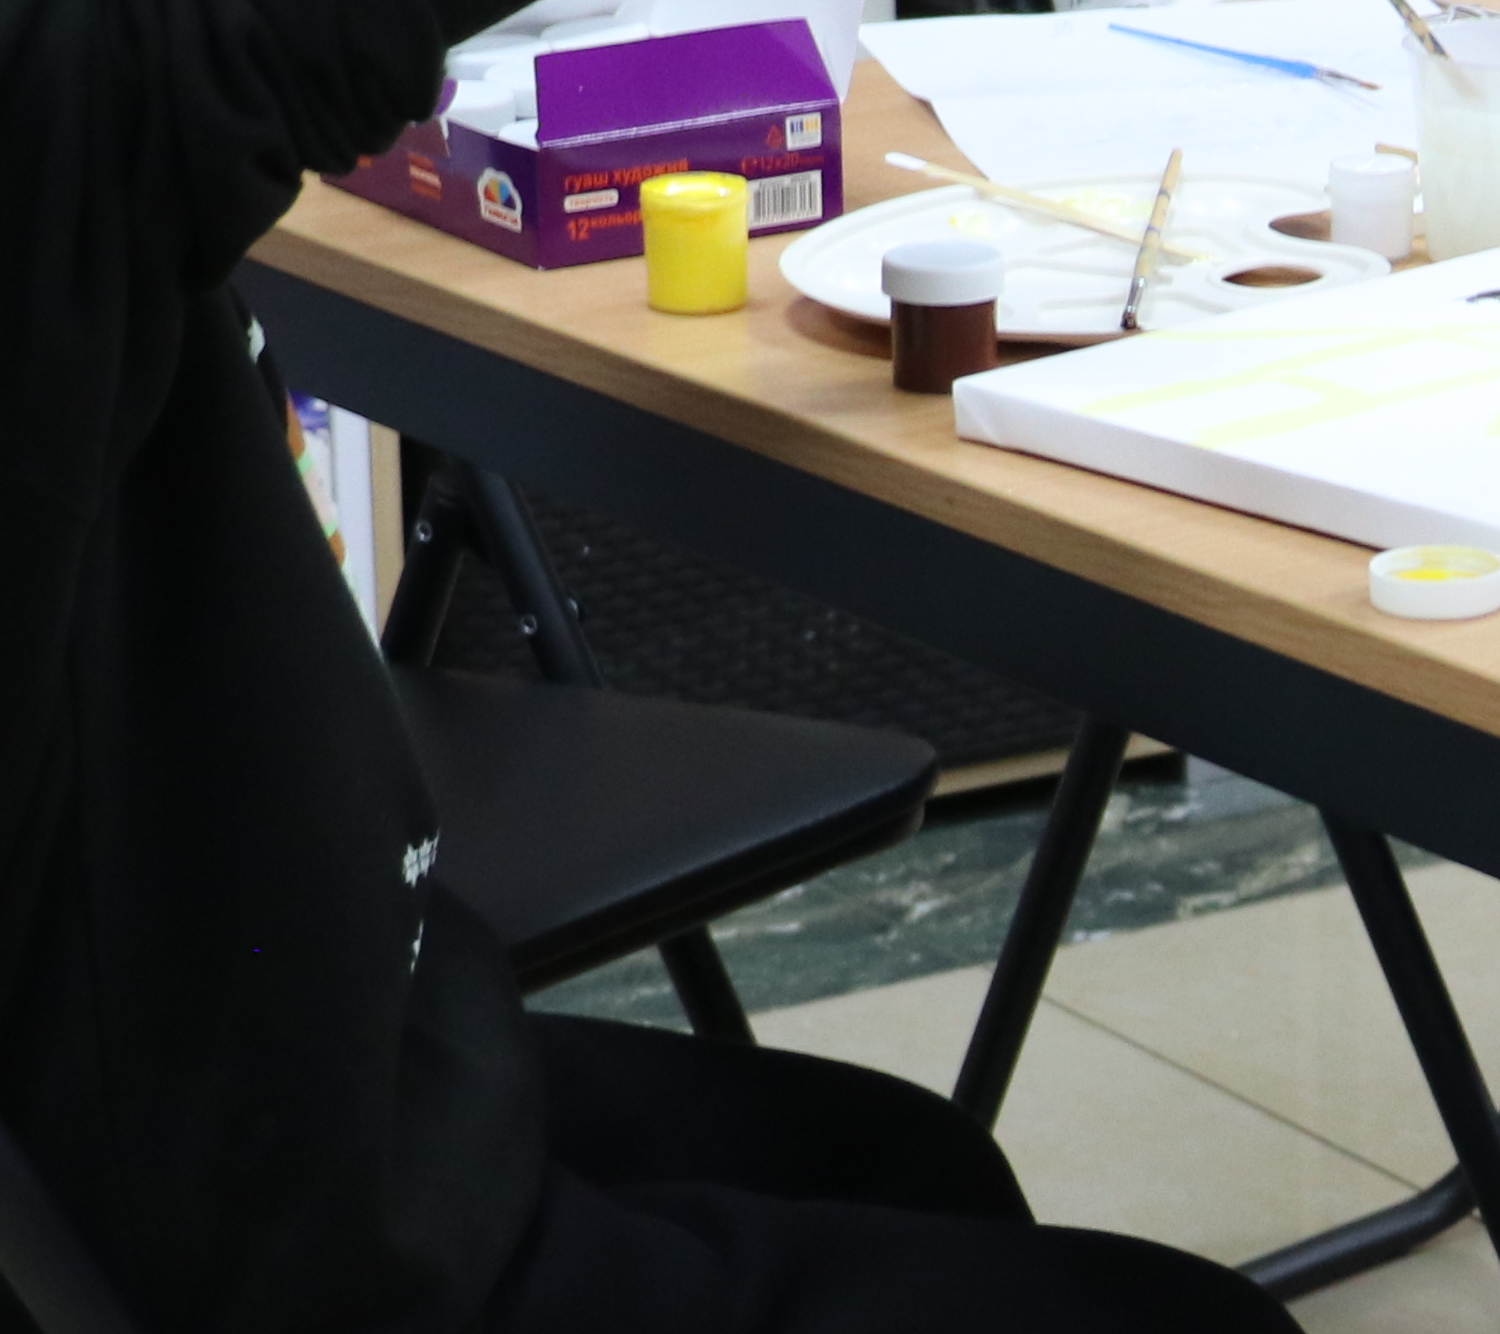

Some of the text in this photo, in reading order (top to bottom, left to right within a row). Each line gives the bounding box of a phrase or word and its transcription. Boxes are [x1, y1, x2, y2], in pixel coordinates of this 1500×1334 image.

[565, 170, 609, 192] гуаш
[566, 210, 642, 241] 12 кольор
